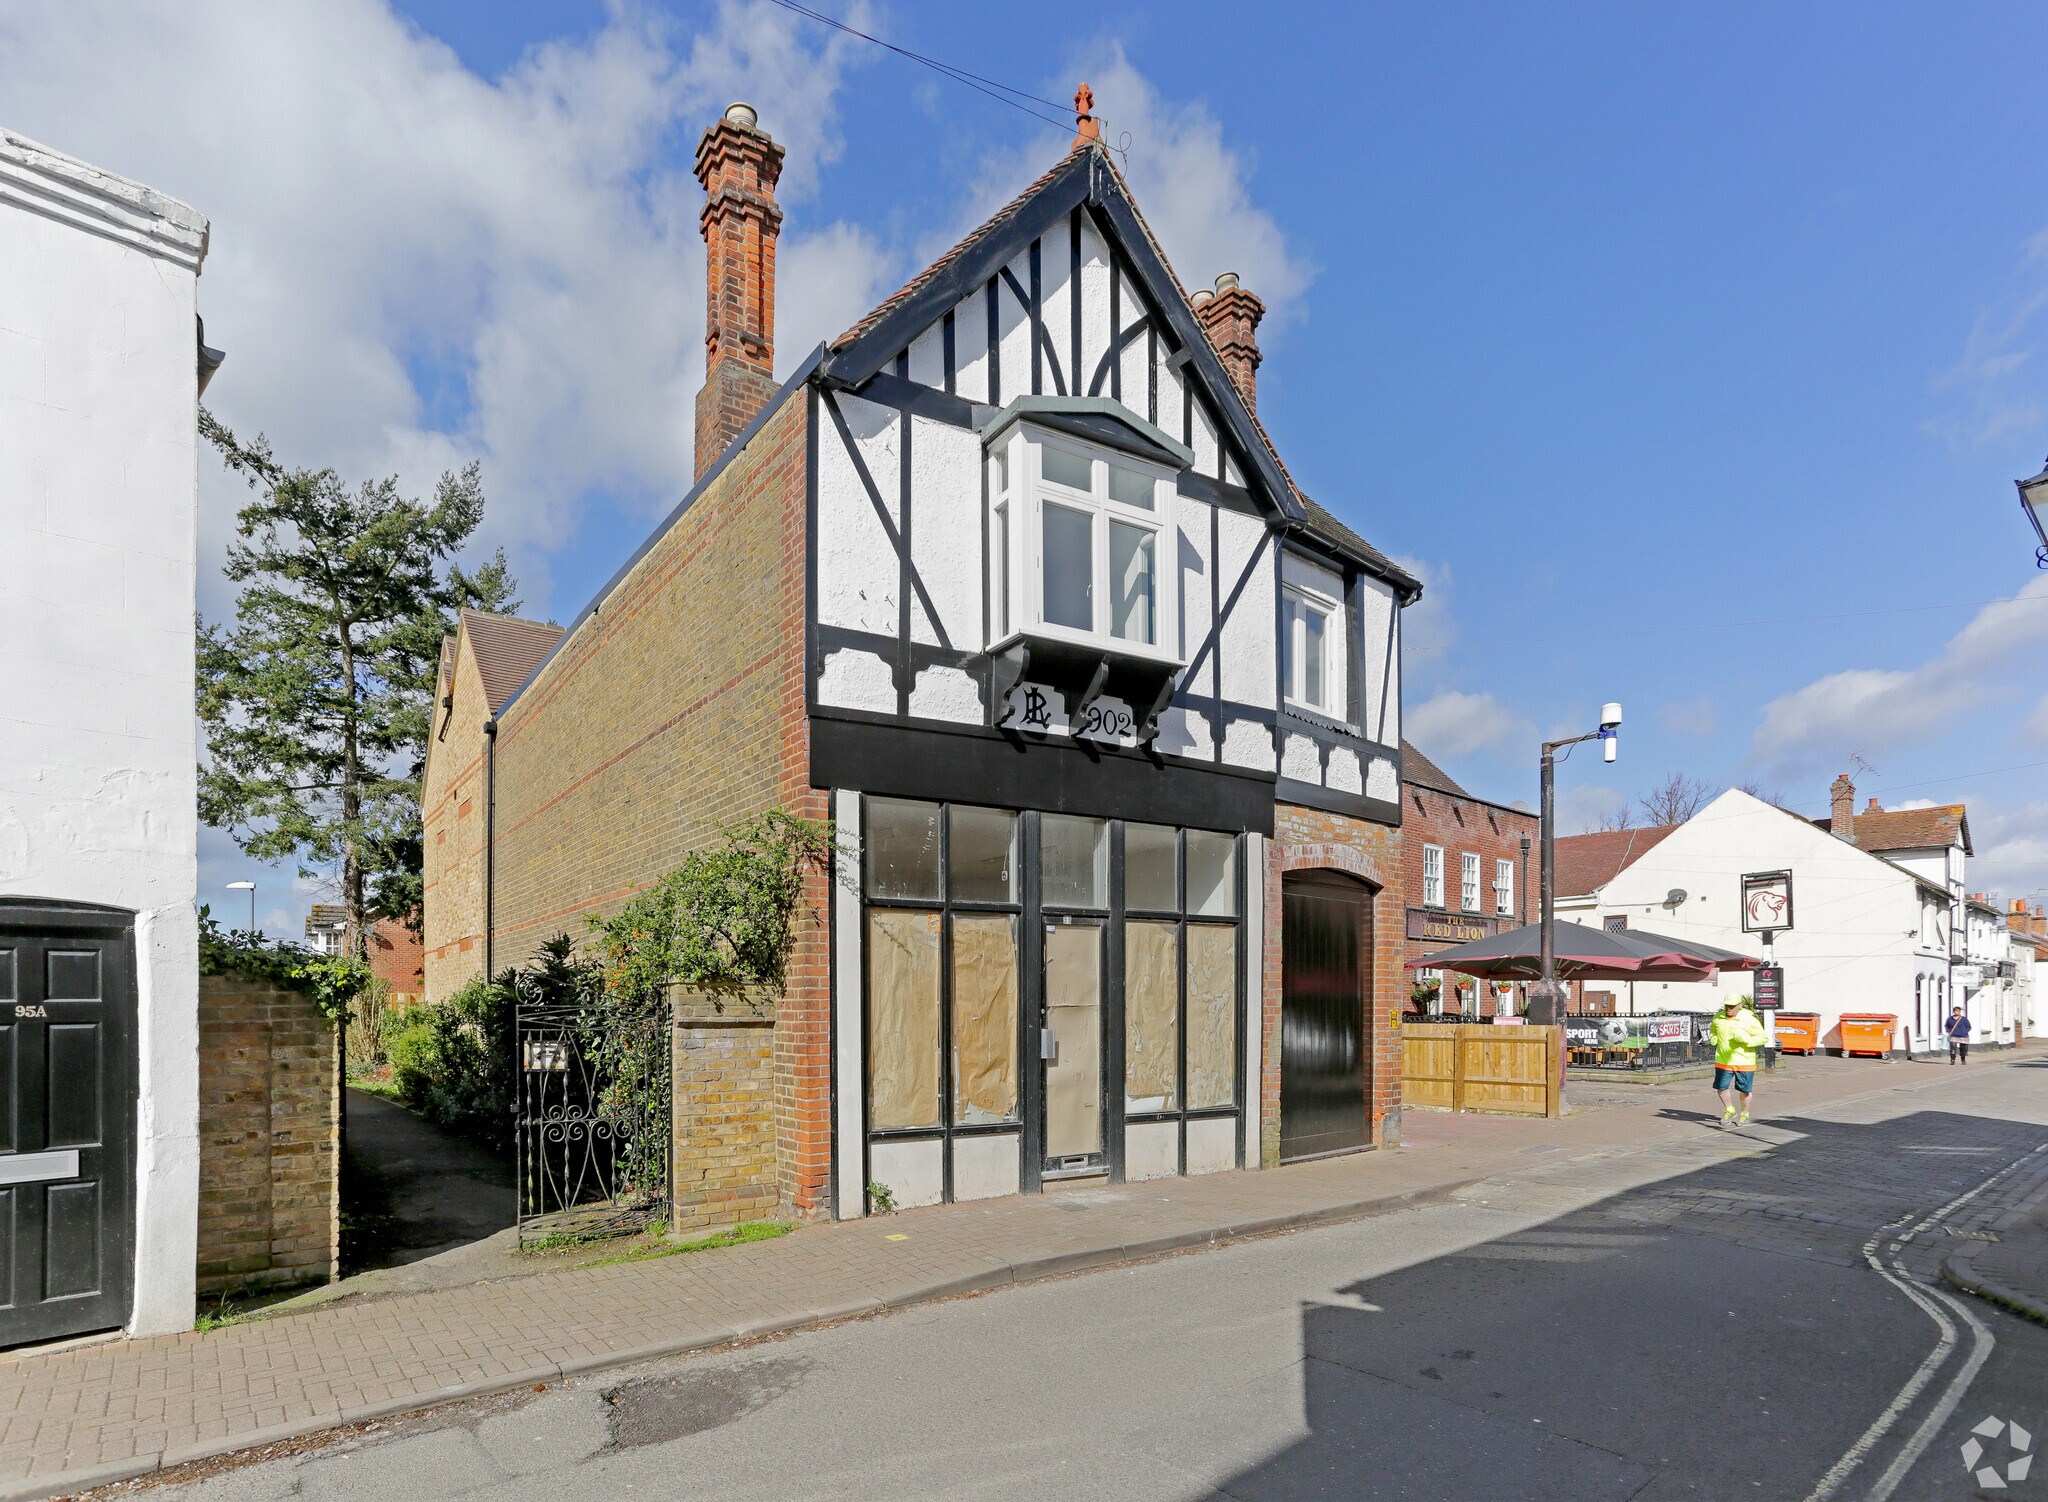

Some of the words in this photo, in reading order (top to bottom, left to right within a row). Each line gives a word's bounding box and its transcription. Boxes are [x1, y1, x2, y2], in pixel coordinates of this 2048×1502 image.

[1446, 916, 1465, 926] THE
[1423, 923, 1452, 937] RED
[1456, 926, 1485, 939] LION
[14, 1005, 47, 1018] 95A
[1566, 1028, 1598, 1039] SPORT
[1659, 1023, 1680, 1036] SPORTS
